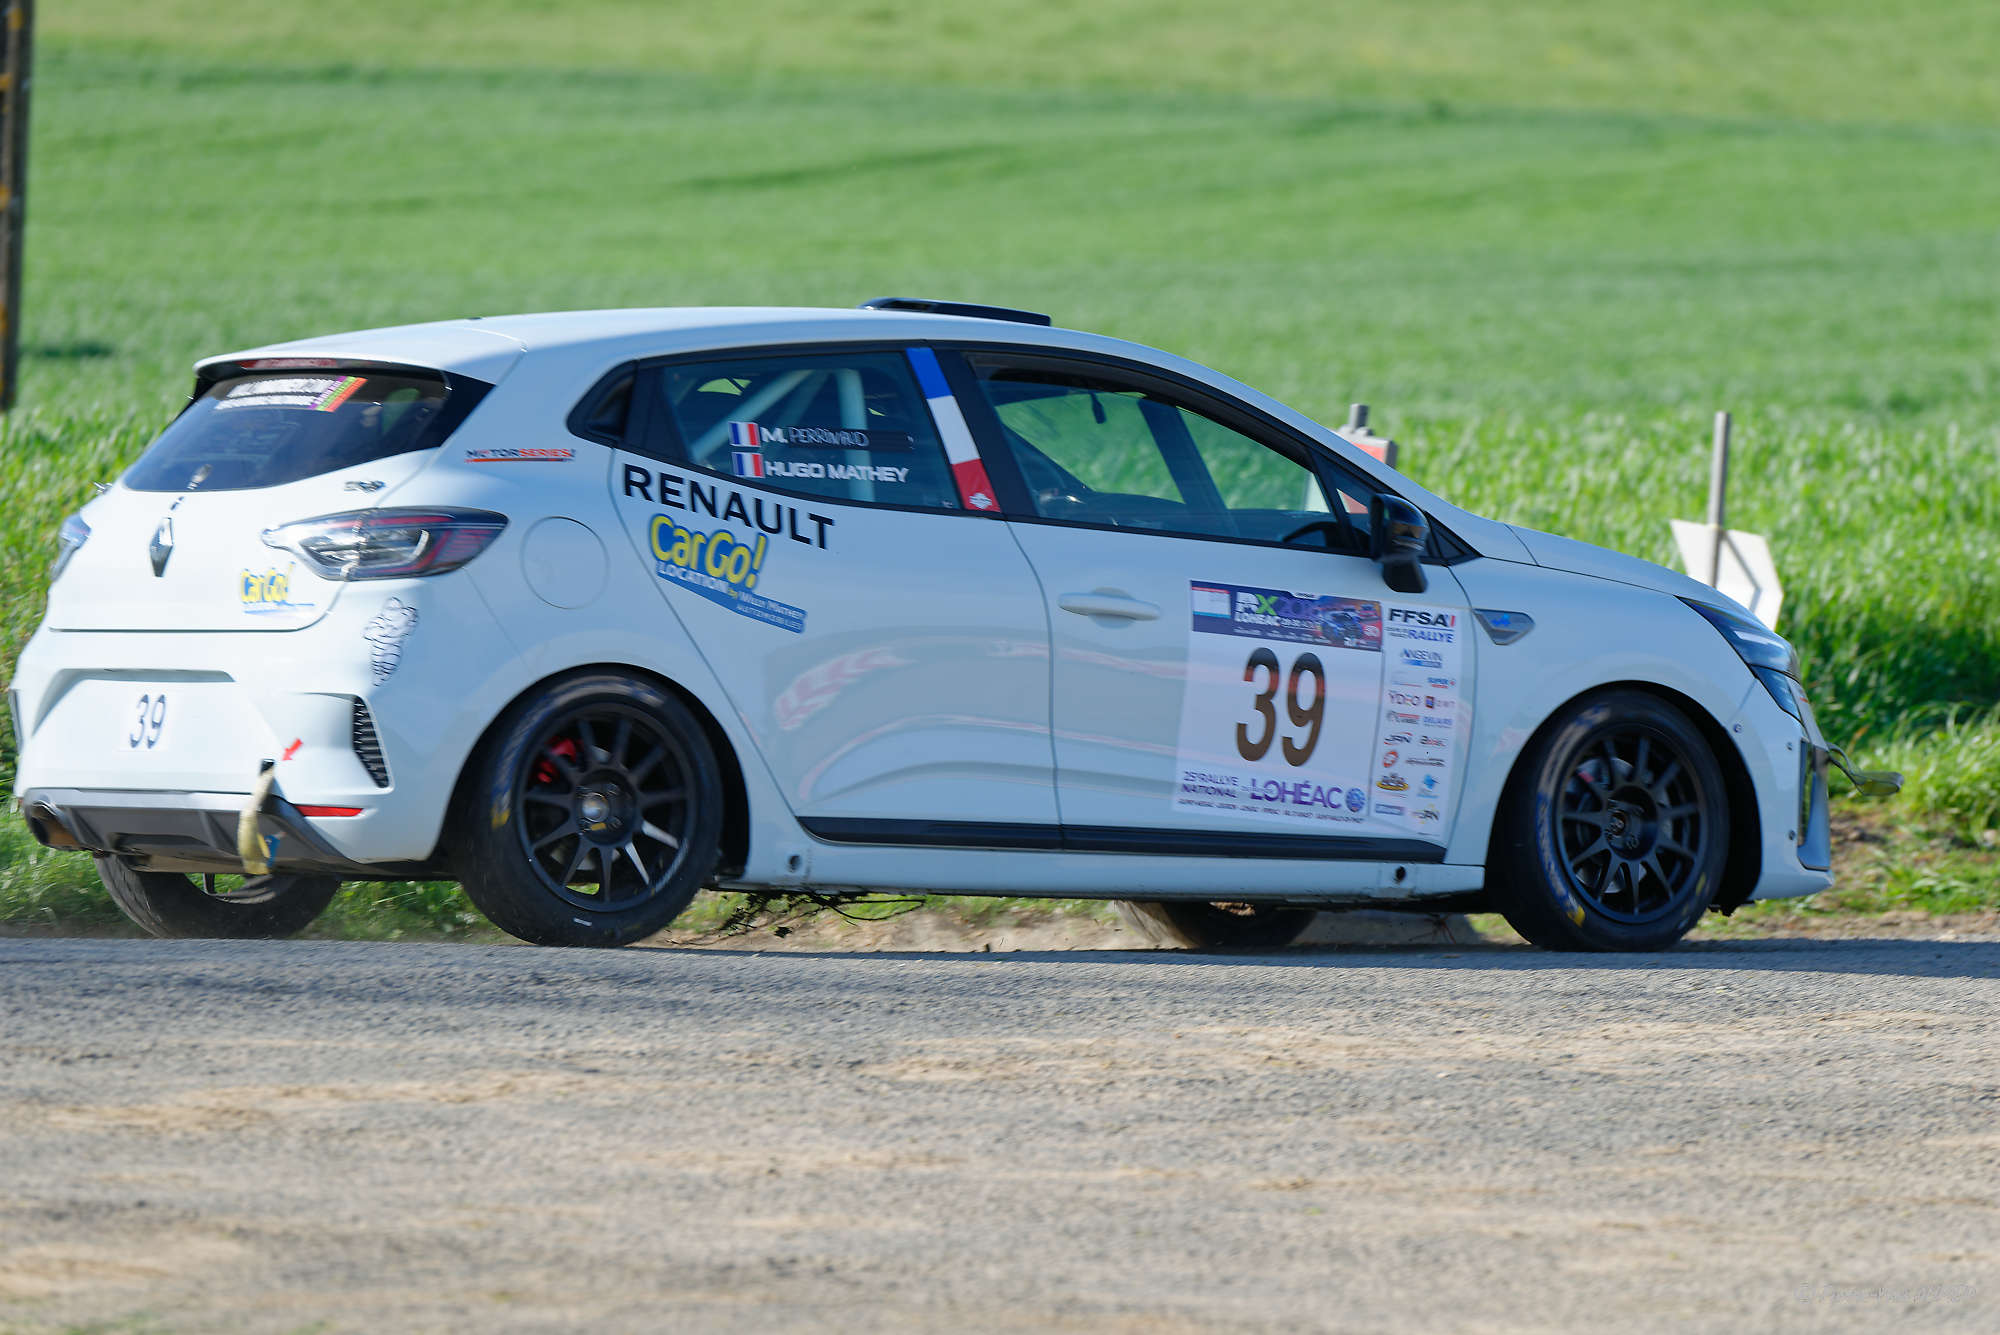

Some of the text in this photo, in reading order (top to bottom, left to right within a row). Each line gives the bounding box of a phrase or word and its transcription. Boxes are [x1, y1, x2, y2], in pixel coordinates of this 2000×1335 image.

[764, 460, 909, 483] HUGO MATHEY
[623, 463, 835, 550] RENAULT
[1389, 608, 1449, 628] FFSA
[1408, 629, 1454, 643] RALLYE
[129, 694, 166, 749] 39
[1236, 647, 1326, 767] 39
[1181, 778, 1343, 809] NATIONAL LOHÉAC
